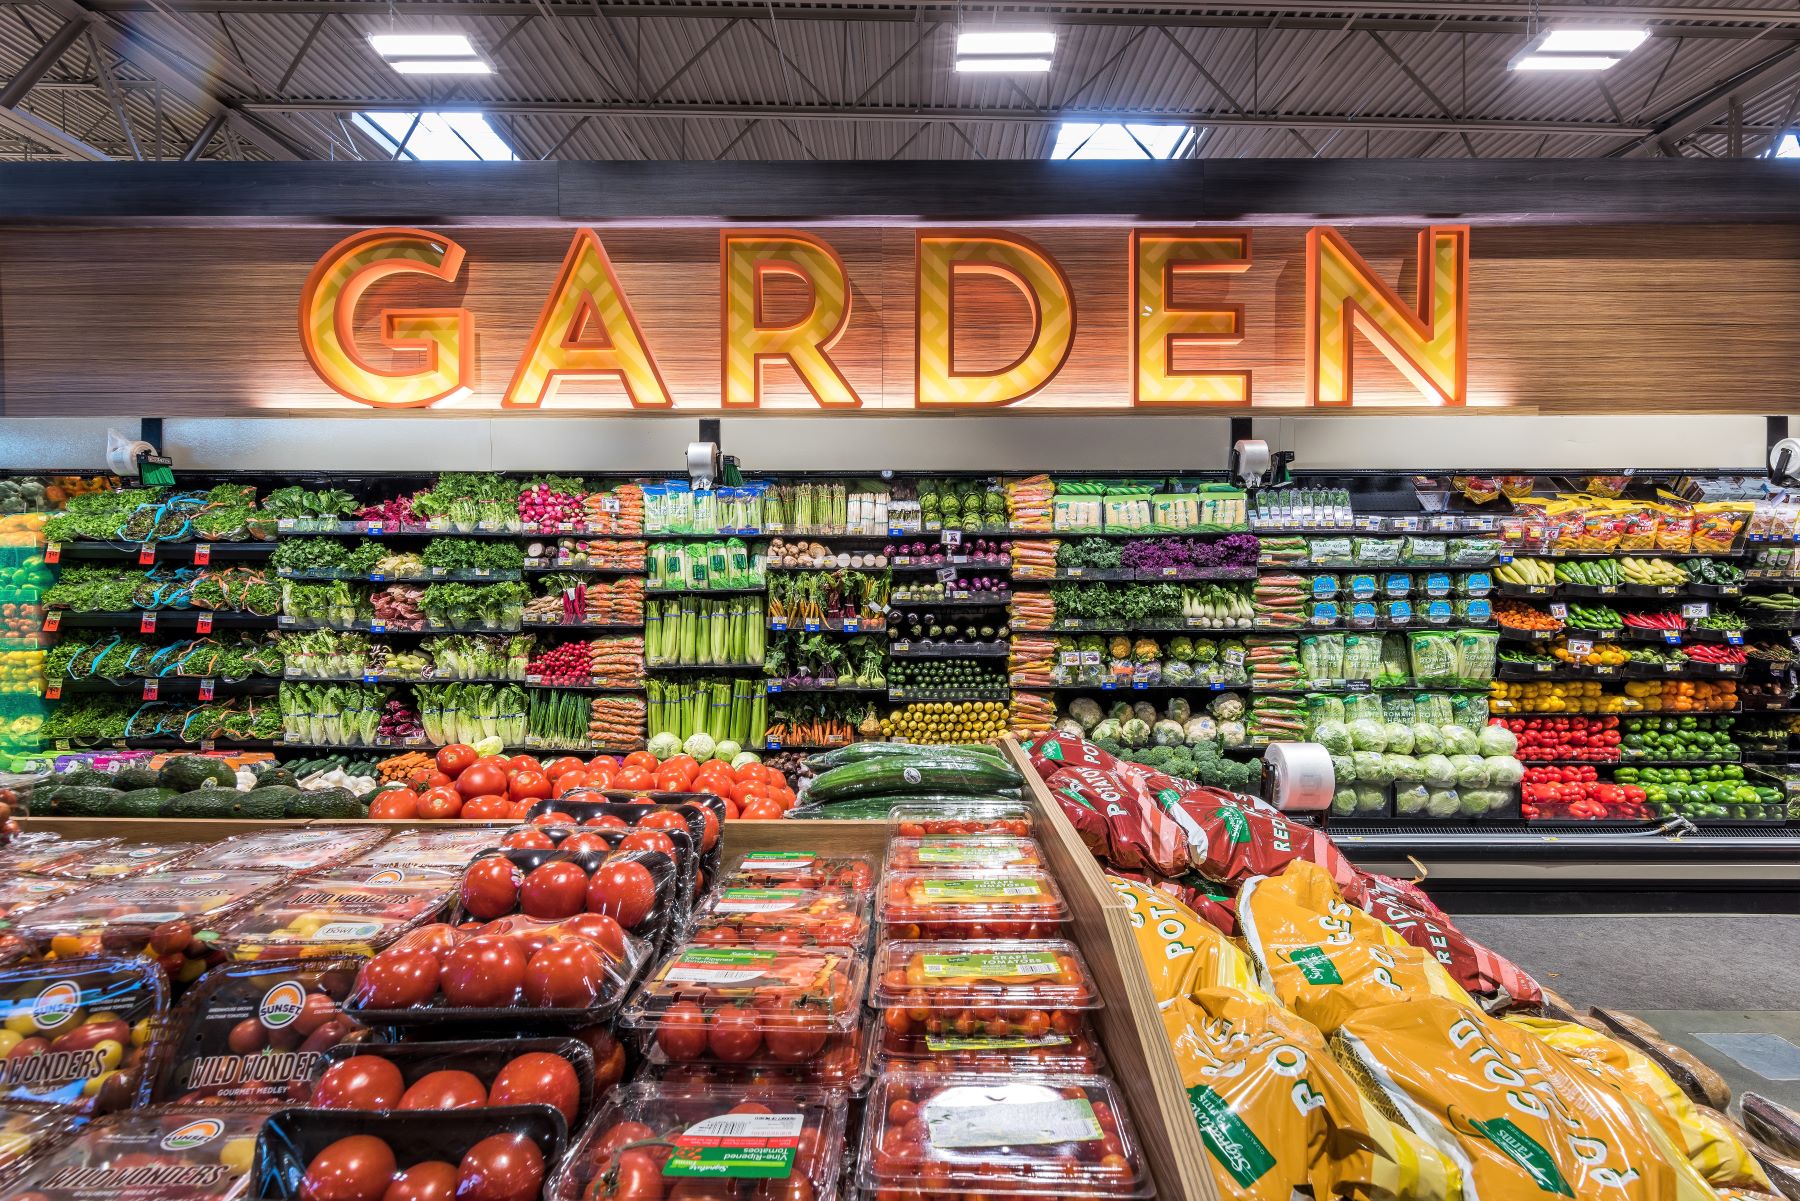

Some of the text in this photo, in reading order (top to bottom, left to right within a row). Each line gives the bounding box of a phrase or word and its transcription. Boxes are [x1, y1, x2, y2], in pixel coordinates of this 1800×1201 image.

[299, 224, 1471, 409] GARDEN
[1273, 819, 1292, 852] RED
[1424, 922, 1453, 964] RED
[33, 1003, 78, 1016] SUNSET
[260, 1003, 302, 1017] SUNSET
[8, 1048, 108, 1085] WONDERS
[187, 1051, 321, 1089] WILD WONDER
[1448, 1017, 1550, 1120] GOLD
[217, 1086, 289, 1097] GOURMET MEDLEY
[1197, 1094, 1232, 1131] Farms
[723, 1153, 788, 1161] Vine-Ripened
[1497, 1129, 1535, 1161] Farms
[41, 1164, 229, 1190] WILD WONDERS
